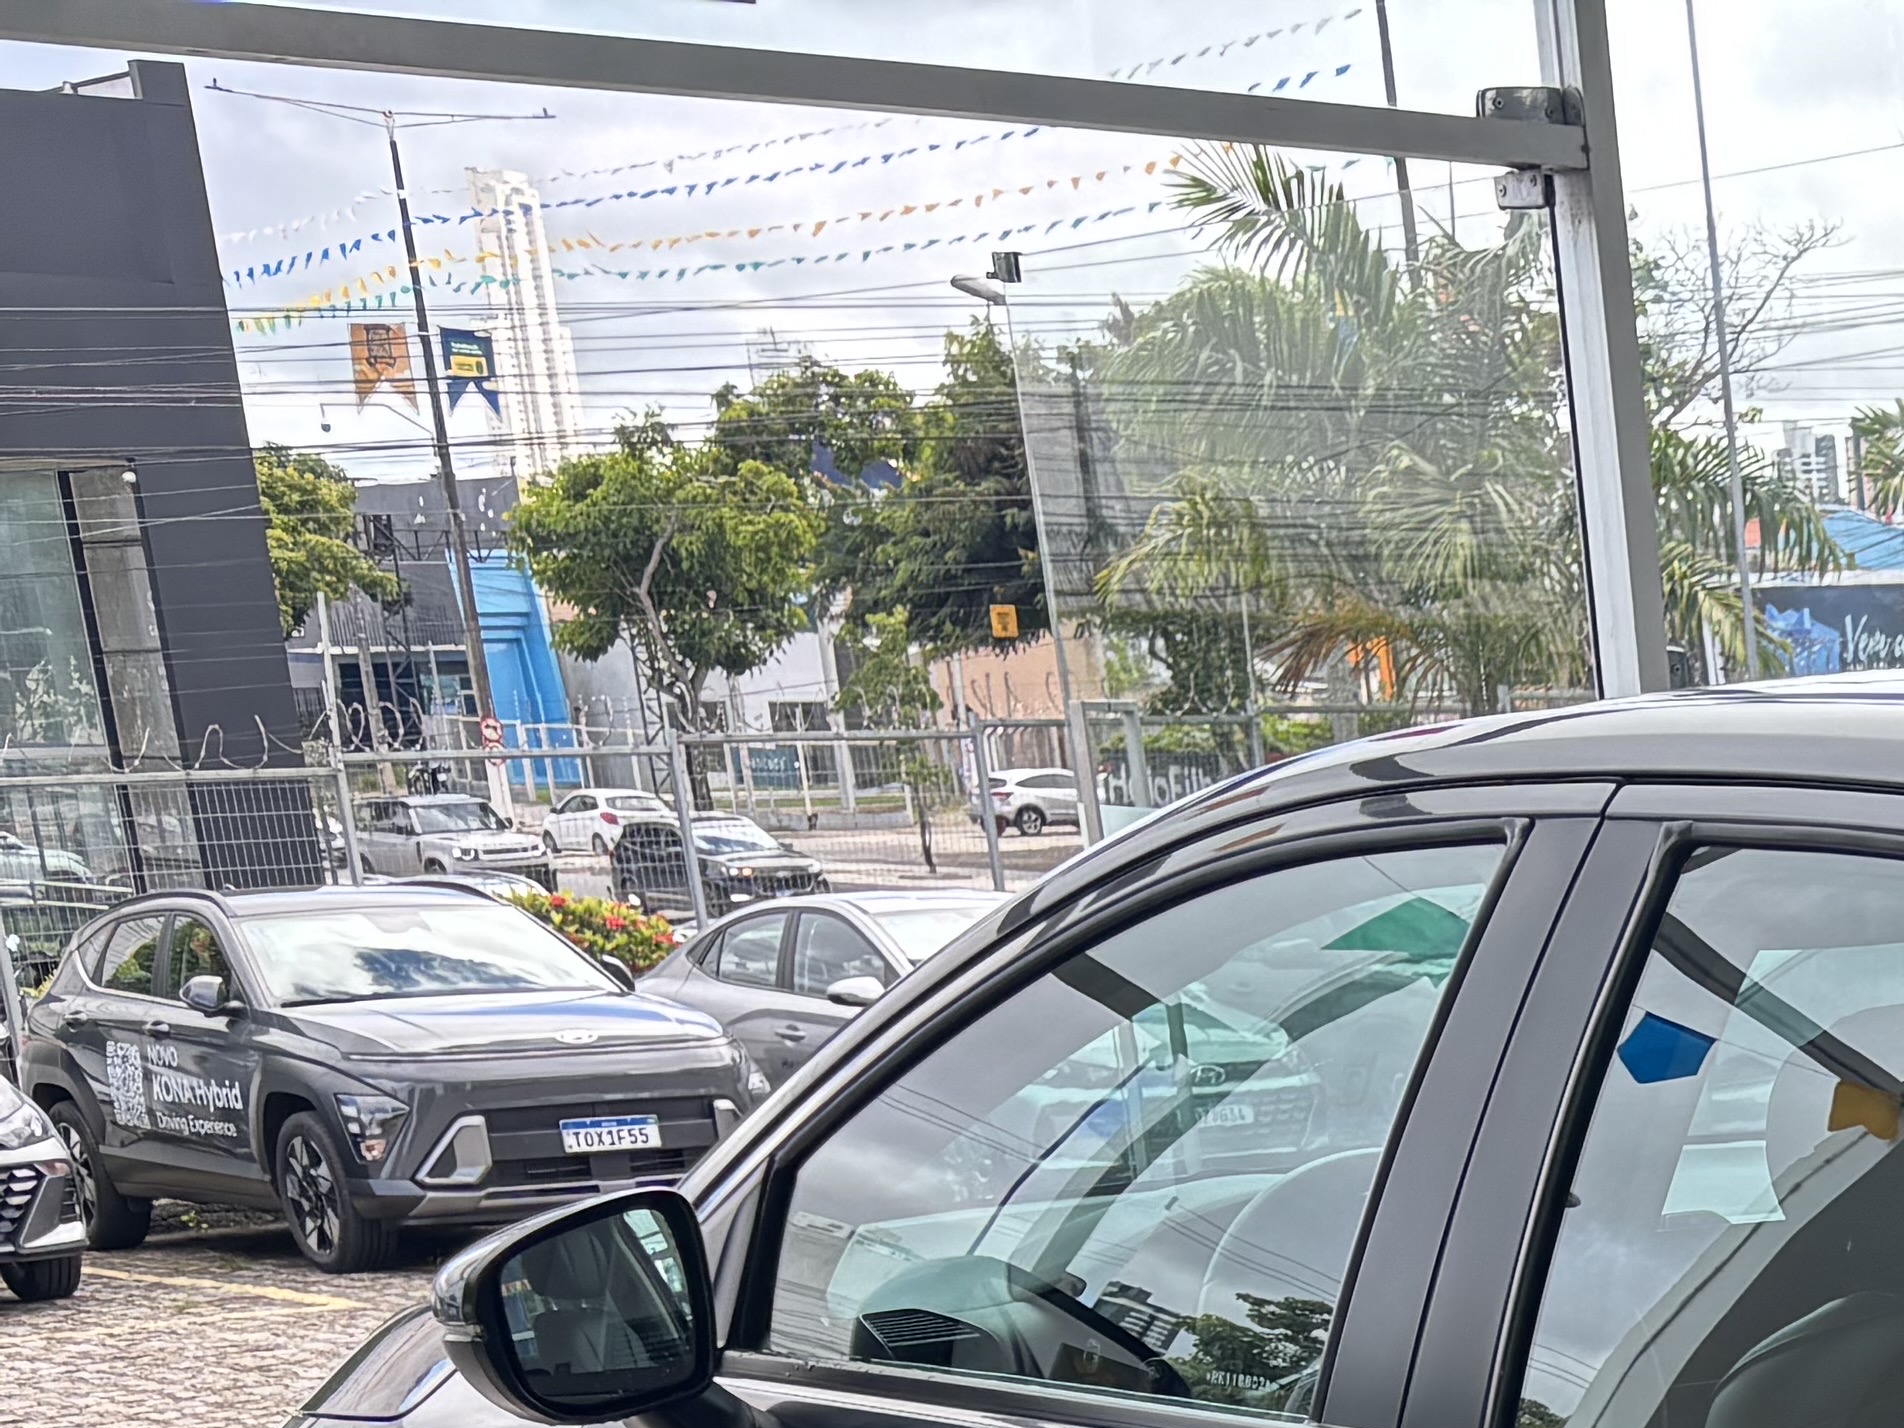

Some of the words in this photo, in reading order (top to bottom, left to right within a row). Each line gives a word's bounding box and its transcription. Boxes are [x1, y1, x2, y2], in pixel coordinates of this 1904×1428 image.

[147, 1044, 178, 1067] NOVO
[152, 1073, 195, 1105] KONA
[193, 1078, 244, 1113] Hybrid
[572, 1128, 649, 1148] TOX1F55
